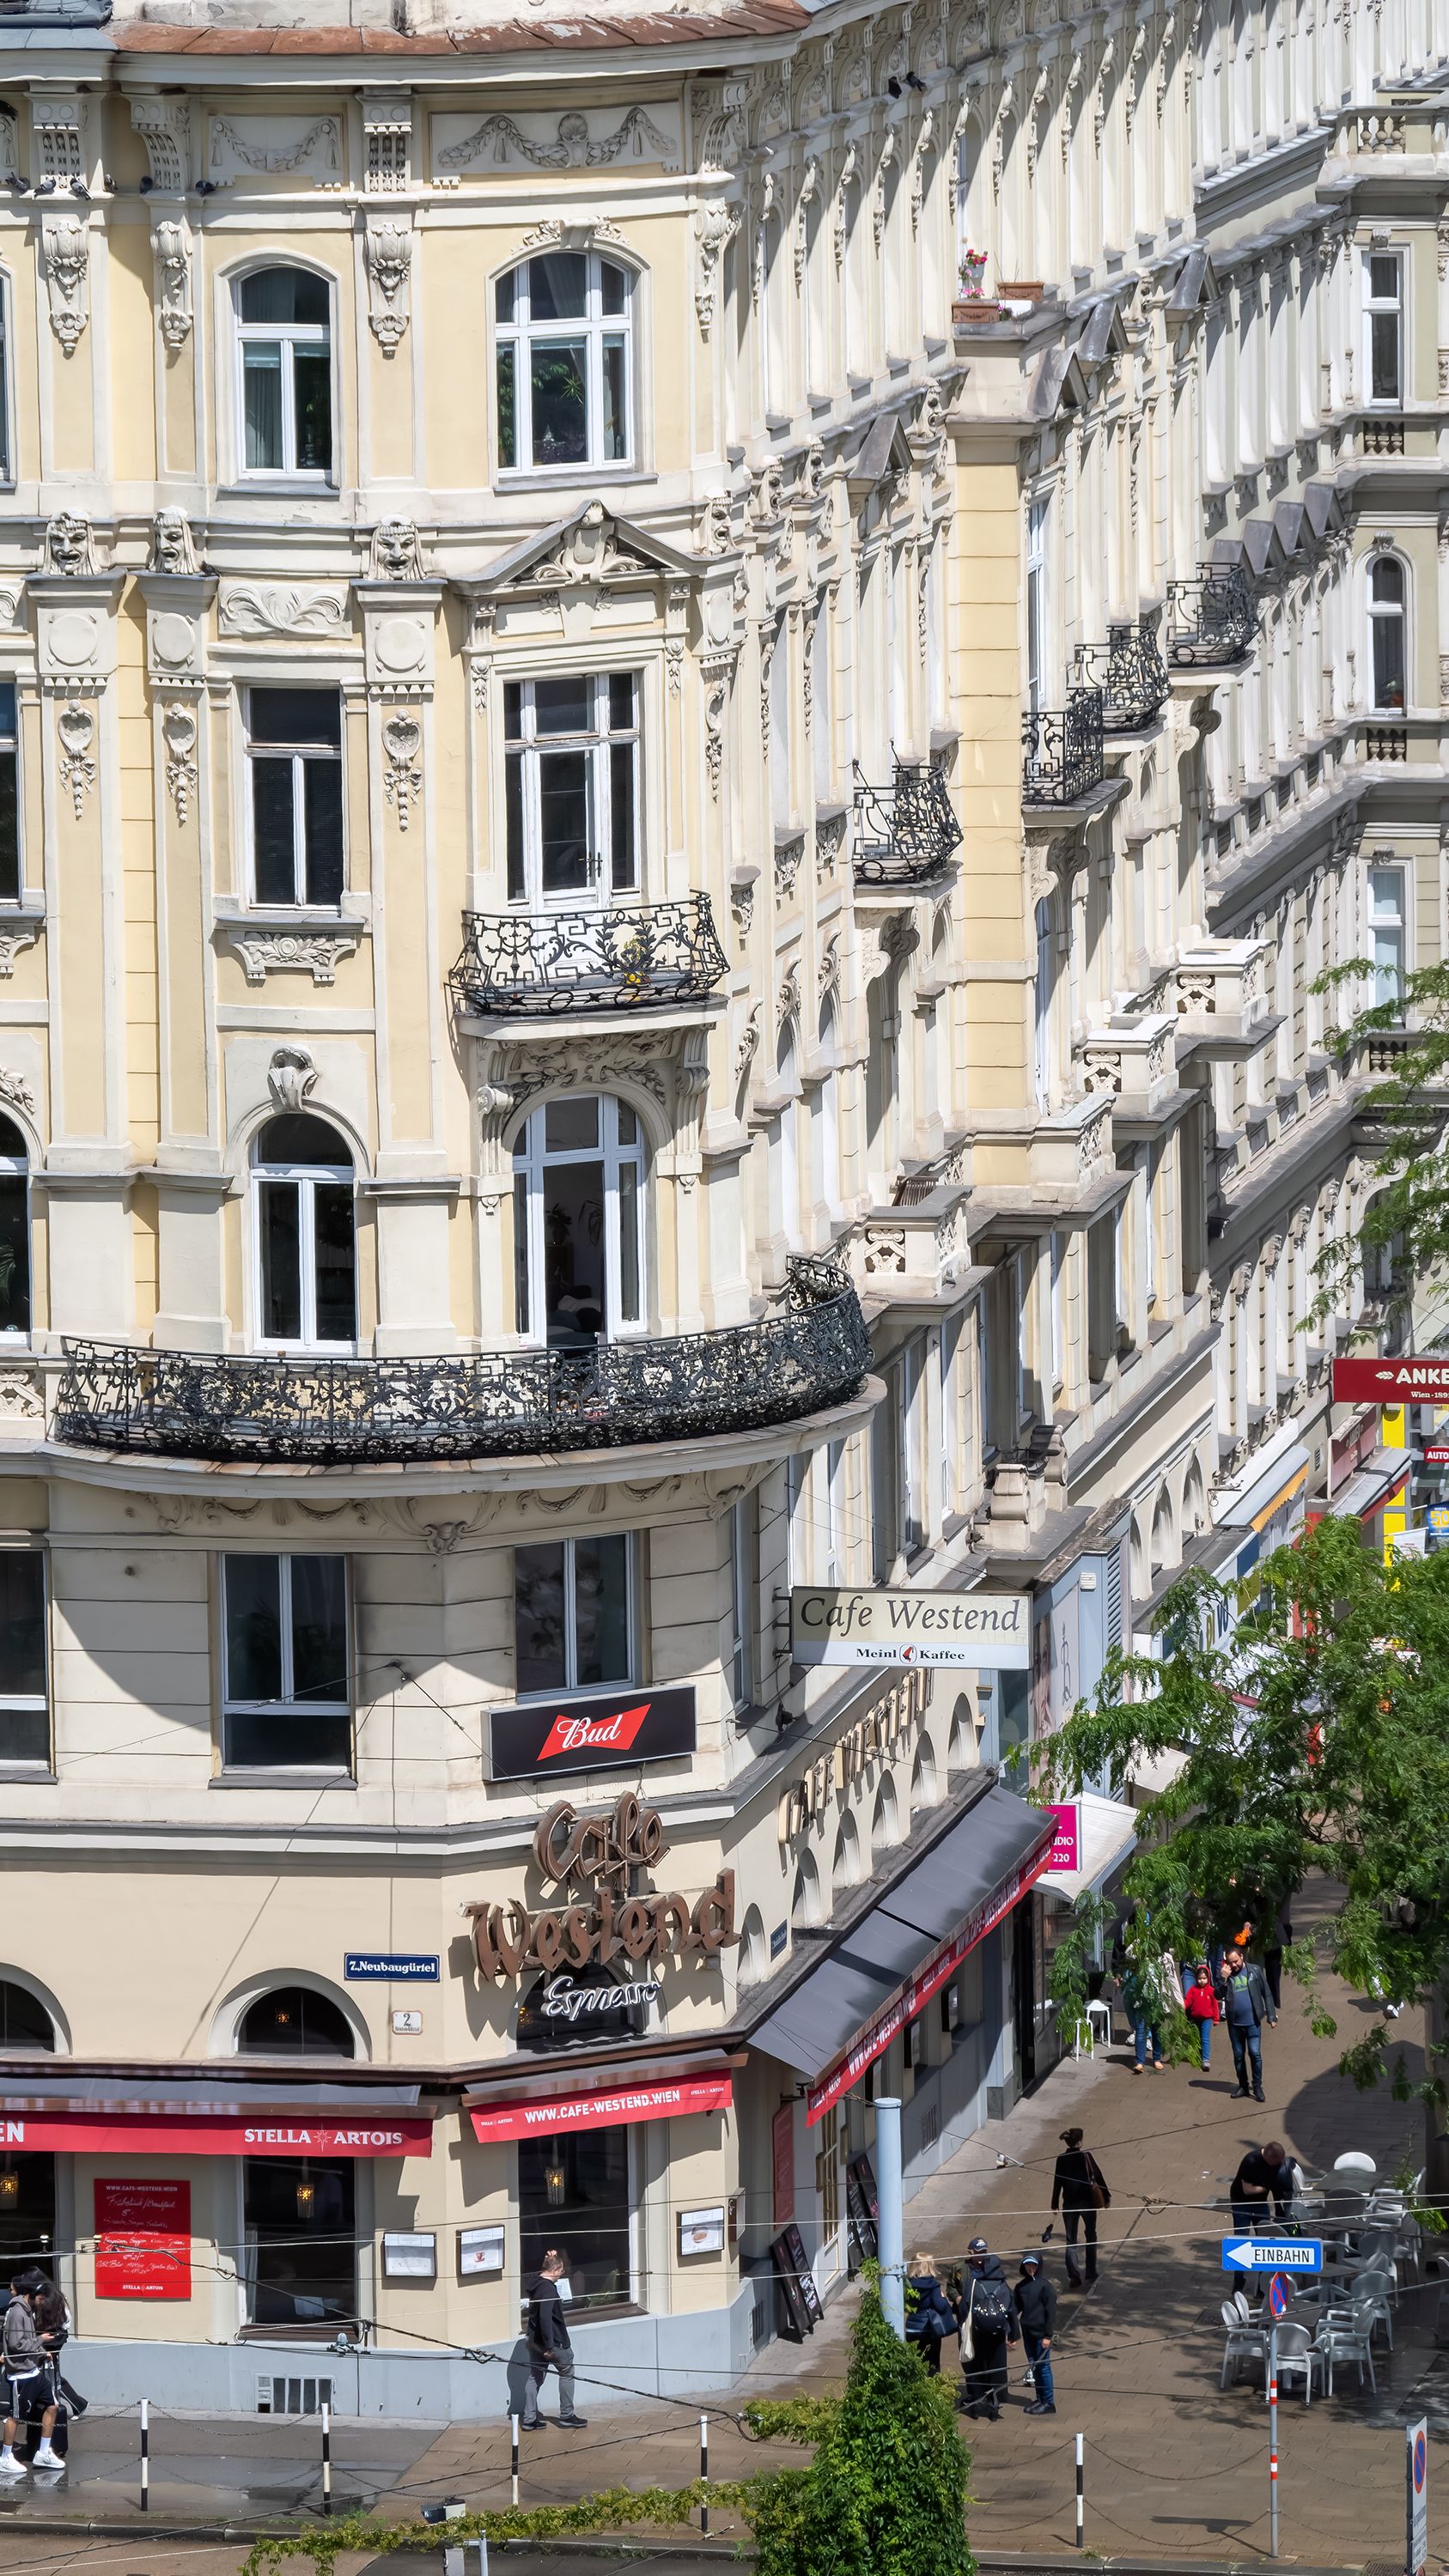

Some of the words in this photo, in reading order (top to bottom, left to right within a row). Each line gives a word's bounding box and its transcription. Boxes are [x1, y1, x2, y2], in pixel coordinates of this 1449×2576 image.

[801, 1595, 873, 1637] Cafe
[886, 1599, 1020, 1631] Westend
[856, 1648, 897, 1658] Meinl
[919, 1649, 965, 1661] Kaffee
[557, 1714, 624, 1748] Bud
[455, 1867, 743, 1983] Westend
[359, 1961, 435, 1974] Neubaugürtel
[541, 1975, 661, 2021] Espresso
[403, 2013, 411, 2027] 2
[525, 2090, 680, 2123] WWW.CAFE-WESTEND.WIEN
[244, 2129, 311, 2143] STELLA
[333, 2131, 402, 2145] ARTOIS
[1255, 2249, 1310, 2263] EINBAHN
